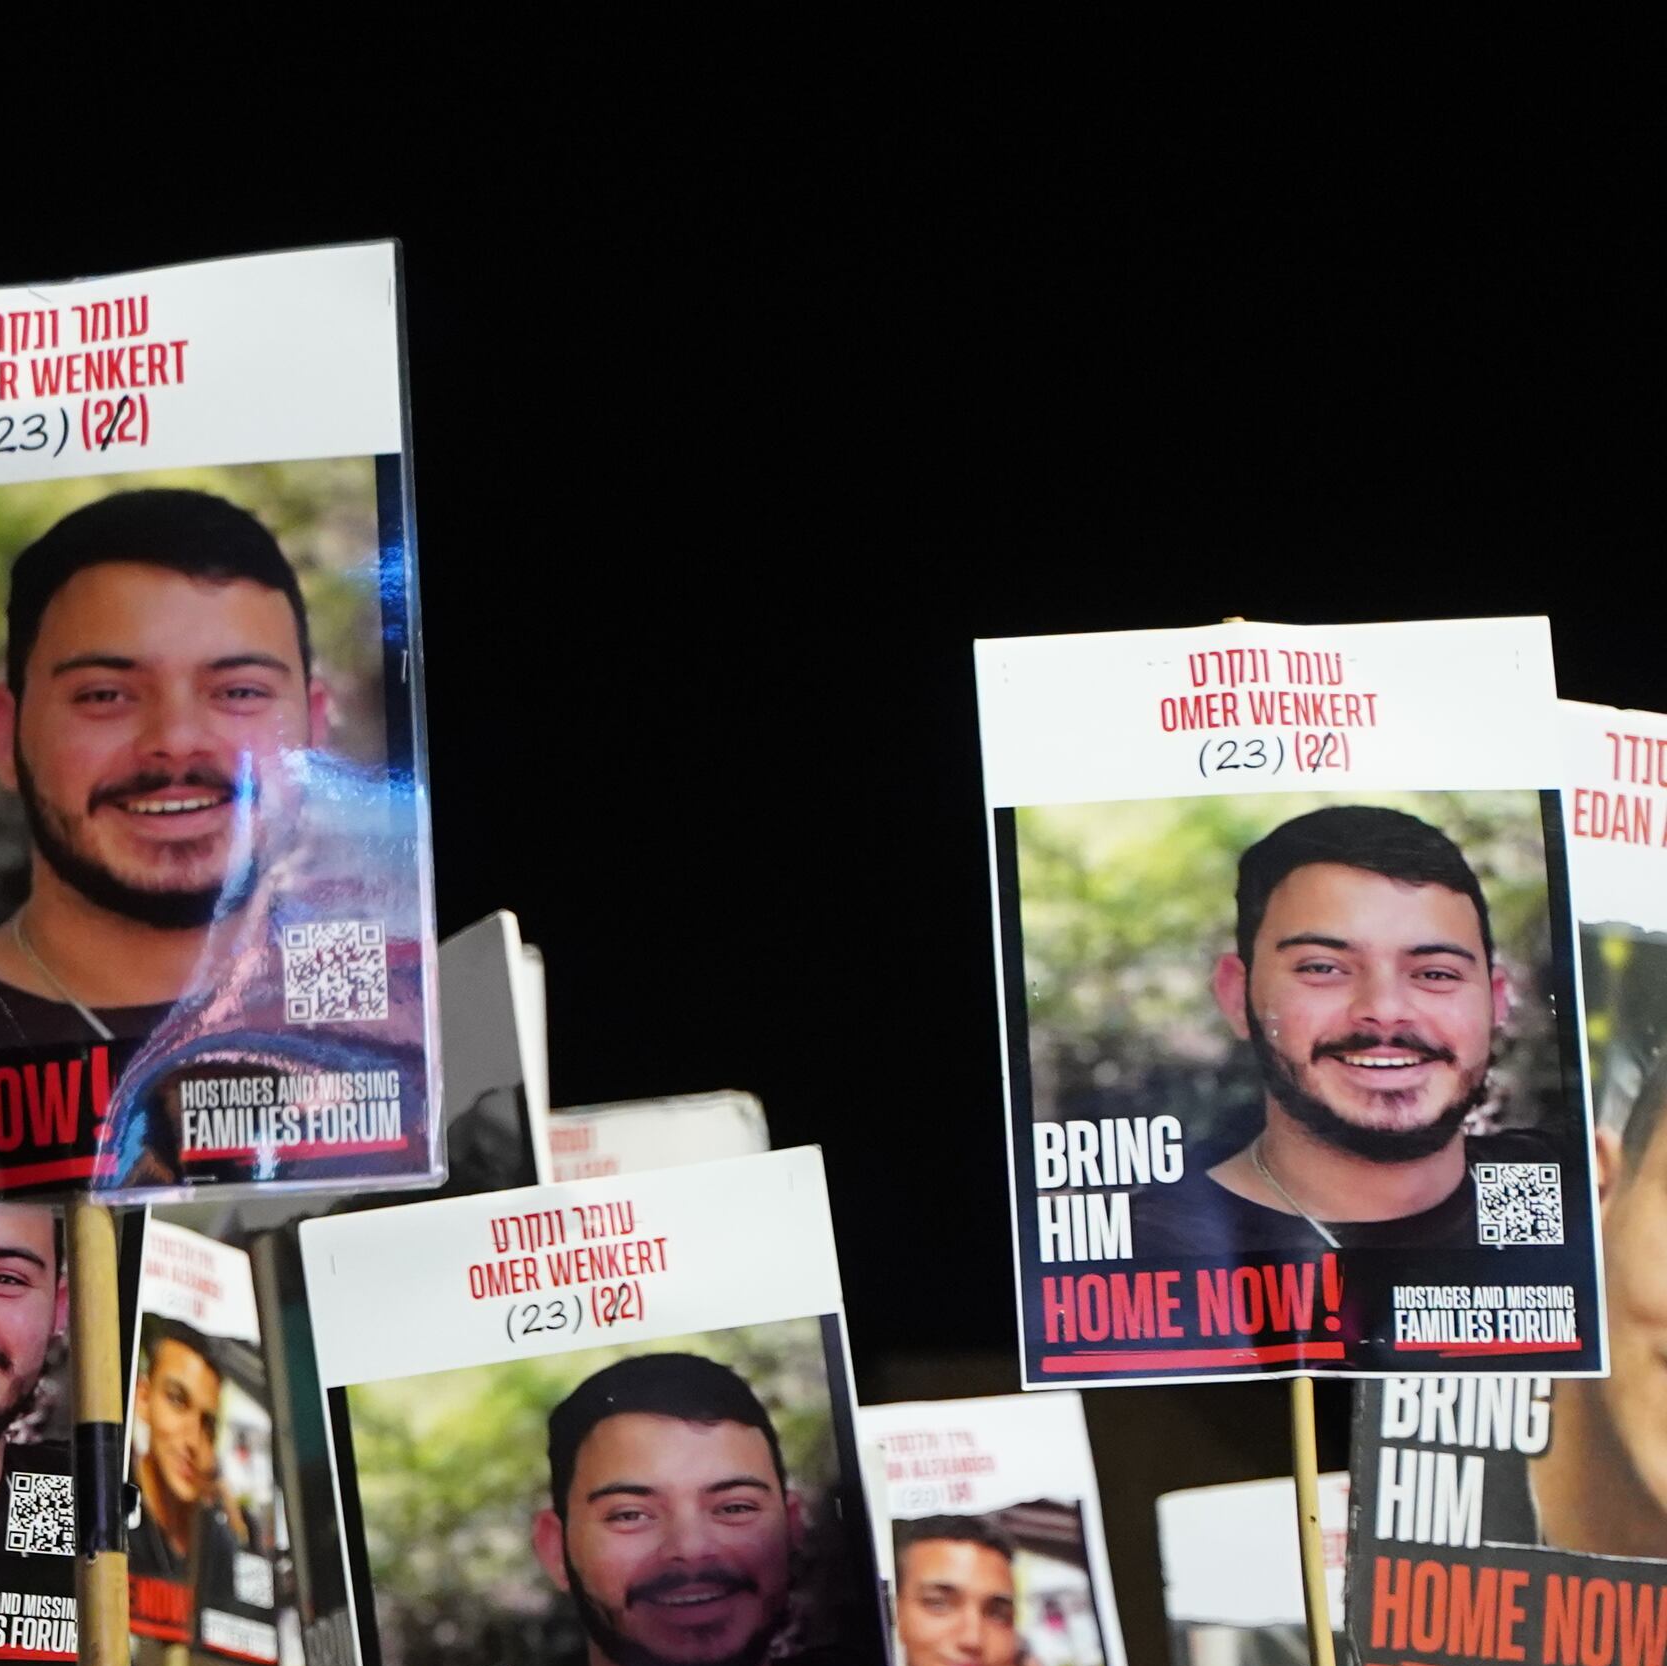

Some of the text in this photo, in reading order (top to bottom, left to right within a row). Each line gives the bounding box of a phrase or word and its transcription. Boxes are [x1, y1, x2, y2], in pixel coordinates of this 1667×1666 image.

[71, 294, 149, 344] עומר
[31, 340, 188, 397] WENKERT
[1189, 649, 1343, 688] עומר ונקרט
[1161, 690, 1378, 732] OMER WENKERT
[1199, 735, 1284, 778] (23)
[1574, 788, 1652, 846] EDAN
[180, 1070, 400, 1109] HOSTAGES AND MISSING
[181, 1099, 404, 1150] FAMILIES FORUM
[1031, 1114, 1184, 1190] BRING
[491, 1201, 635, 1253] עומר ונקרט
[1037, 1193, 1134, 1264] HIM
[469, 1237, 667, 1299] OMER WENKERT
[506, 1295, 583, 1343] (23)
[1040, 1252, 1343, 1344] HOME NOW!
[1393, 1285, 1575, 1311] HOSTAGES AND MISSING
[1394, 1308, 1578, 1344] FAMILIES FORUM
[1381, 1378, 1552, 1454] BRING
[1375, 1446, 1485, 1549] HIM
[22, 1594, 78, 1621] MISSIN
[1371, 1555, 1530, 1662] HOME
